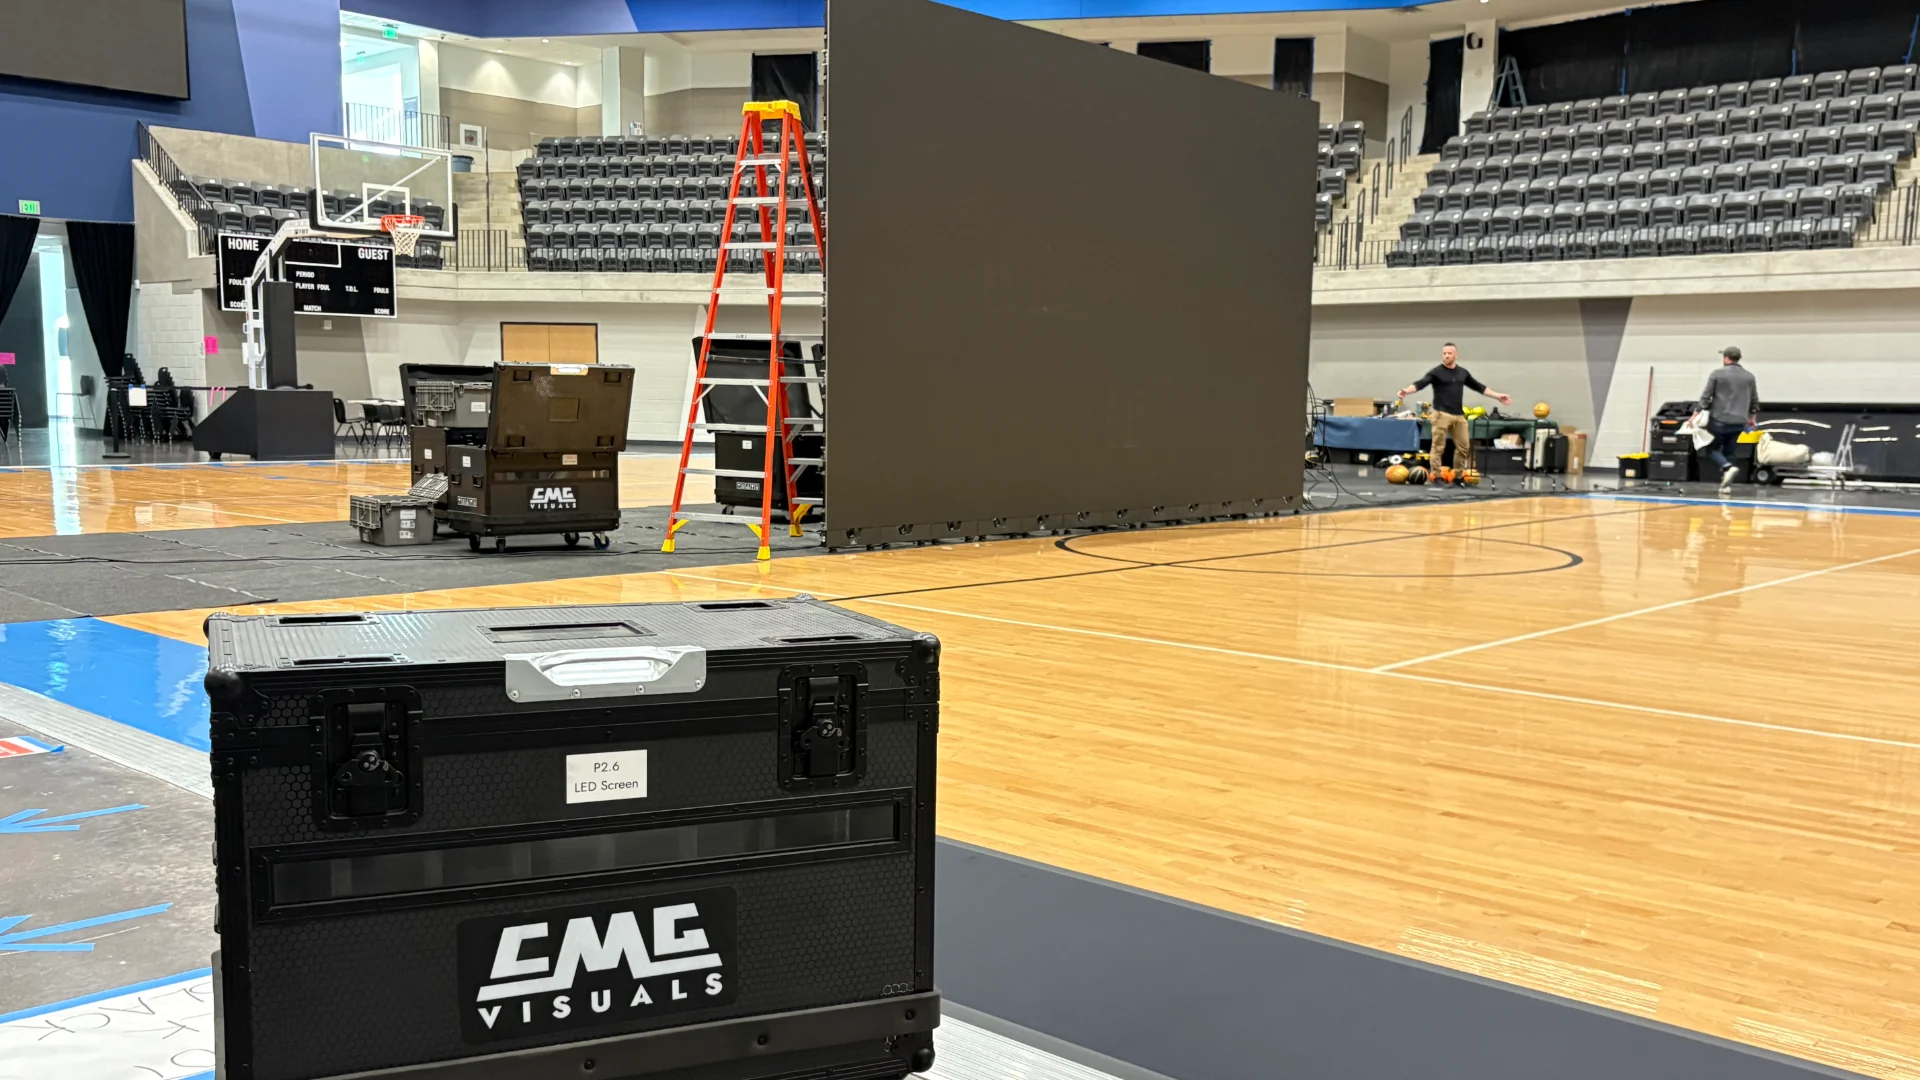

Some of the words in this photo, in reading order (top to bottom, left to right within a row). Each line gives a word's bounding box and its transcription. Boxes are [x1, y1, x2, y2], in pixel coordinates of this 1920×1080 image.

[227, 237, 259, 252] HOME
[357, 247, 390, 261] GUEST
[295, 270, 315, 278] PERIOD
[295, 282, 315, 290] PLAYER
[316, 283, 331, 291] FOUL
[373, 286, 390, 294] FOULS
[303, 304, 322, 312] MATCH
[529, 502, 577, 510] VISUALS
[593, 761, 620, 773] P2.6
[574, 781, 597, 793] LED
[601, 780, 639, 791] Screen
[477, 972, 723, 1029] VISUALS
